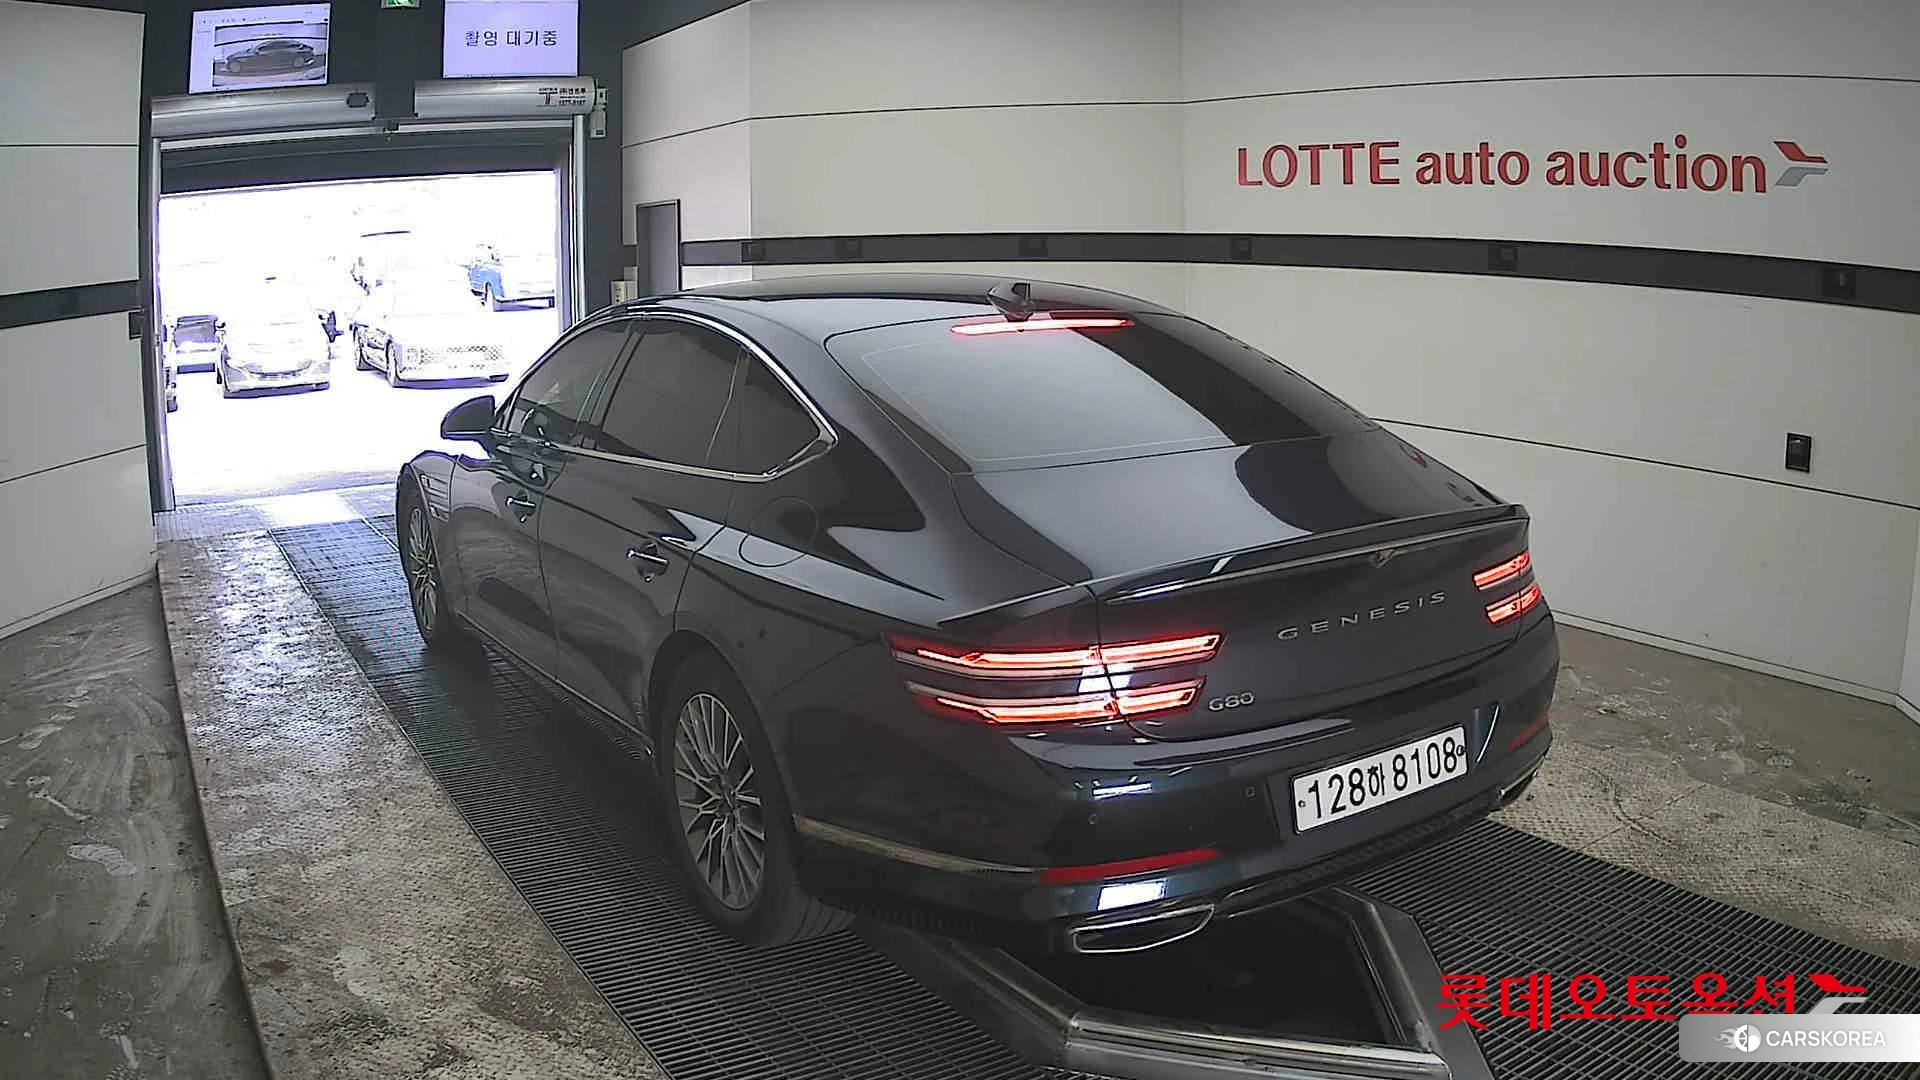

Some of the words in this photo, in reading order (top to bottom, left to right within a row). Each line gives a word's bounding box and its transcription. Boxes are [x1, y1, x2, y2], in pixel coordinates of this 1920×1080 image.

[506, 30, 557, 46] 대기중
[1237, 141, 1400, 187] LOTTE
[1416, 142, 1530, 185] auto
[1545, 134, 1767, 193] auction
[1277, 591, 1447, 641] GENESIS
[1208, 692, 1255, 711] G80
[1393, 736, 1458, 791] 8108
